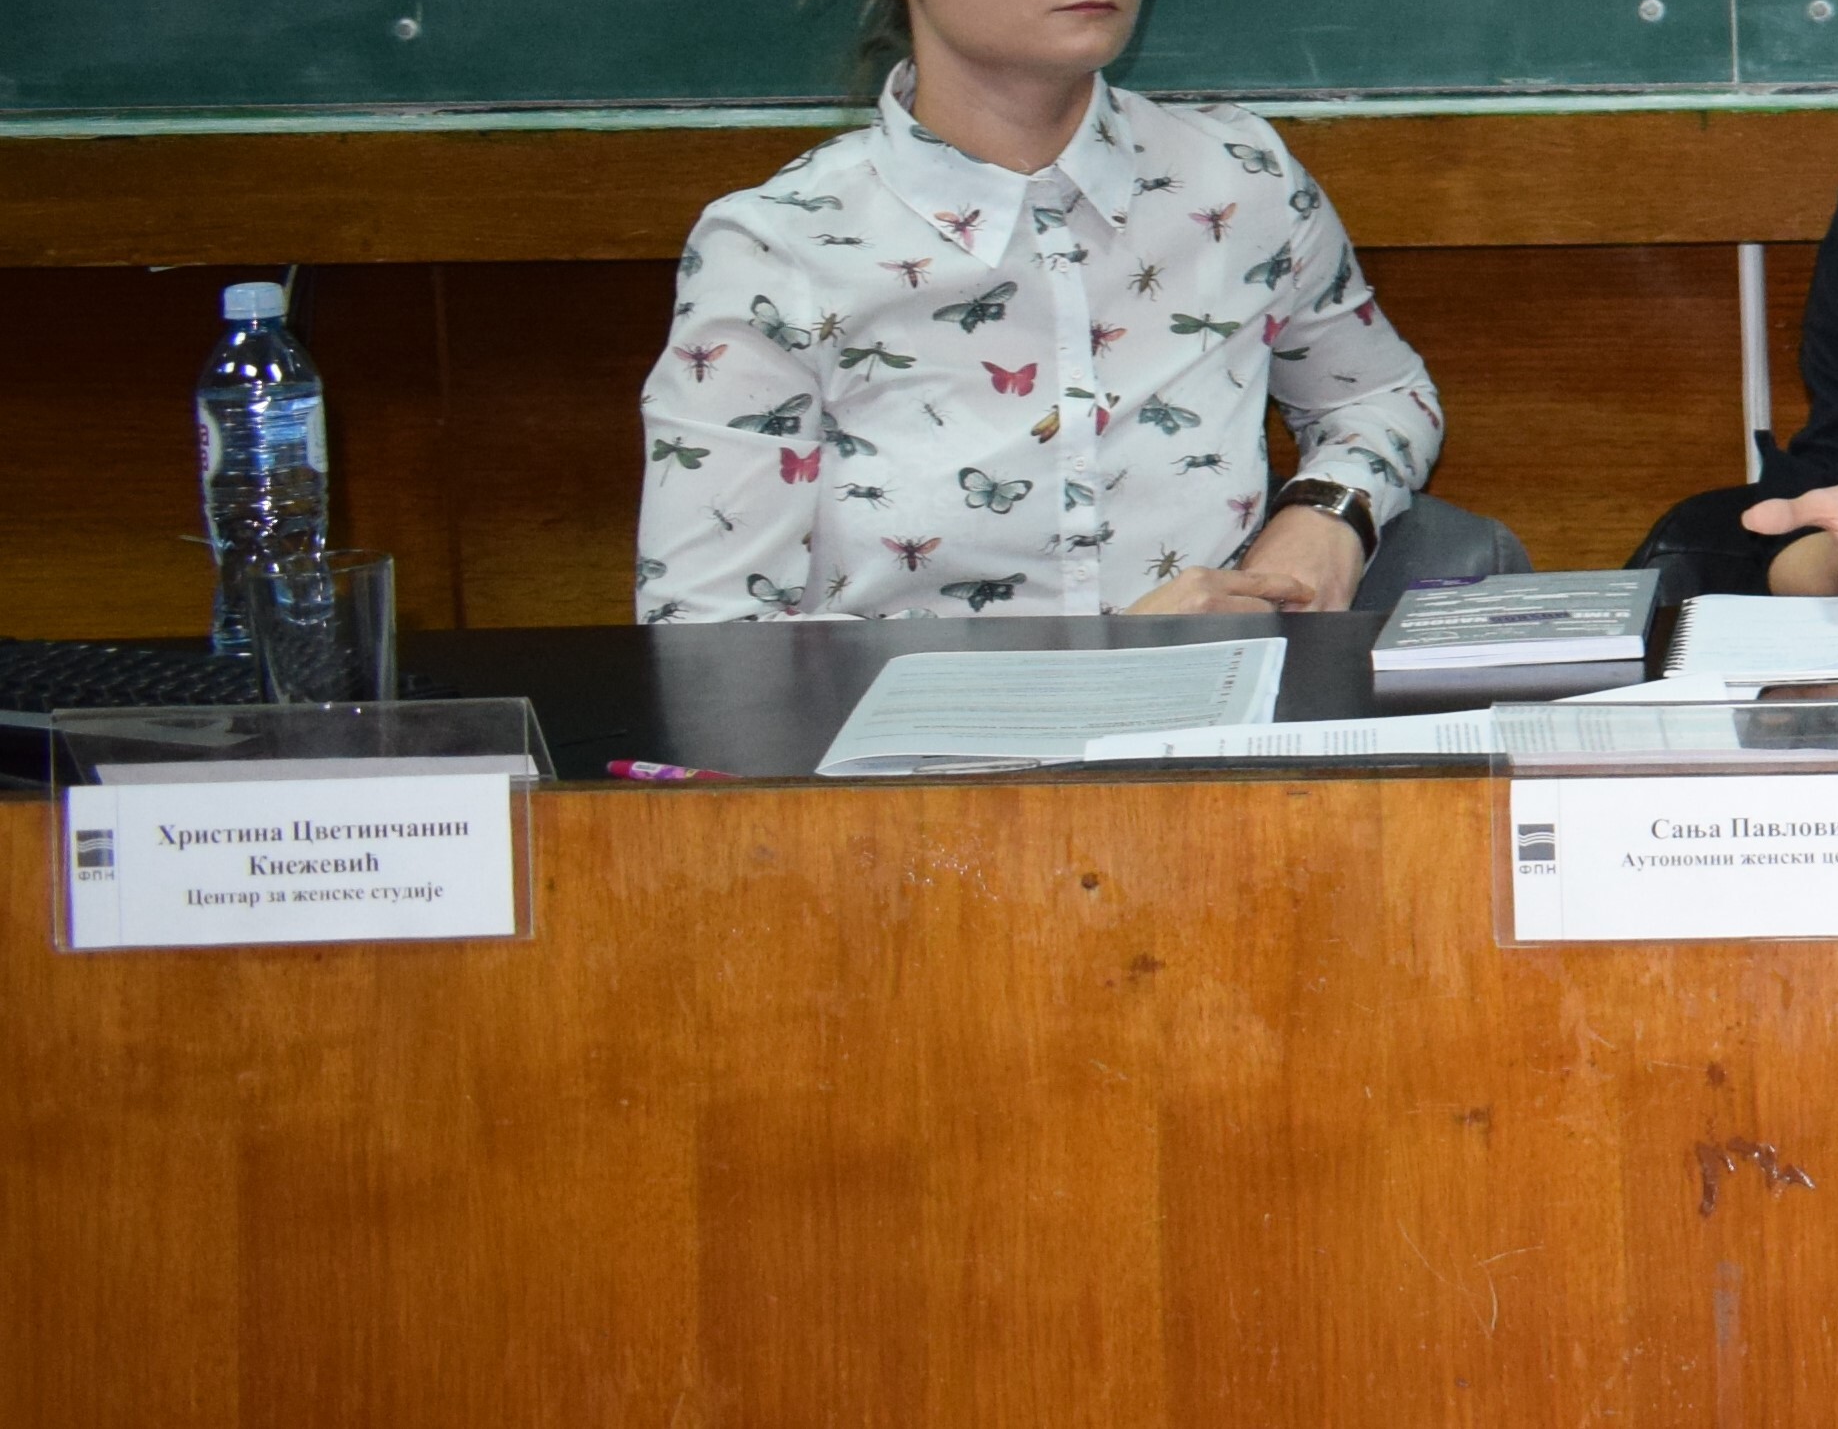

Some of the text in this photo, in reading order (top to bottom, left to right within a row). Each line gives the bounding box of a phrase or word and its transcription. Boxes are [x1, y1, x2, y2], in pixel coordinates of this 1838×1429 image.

[159, 821, 468, 850] Христина Цветинчанин
[1651, 819, 1720, 839] Сања
[250, 852, 378, 875] Кнежевић
[1519, 864, 1556, 874] ФПН
[1623, 853, 1733, 871] Аутономни
[1741, 853, 1814, 865] женски
[78, 870, 114, 881] ФПН
[188, 882, 443, 907] Центар за женске студије
